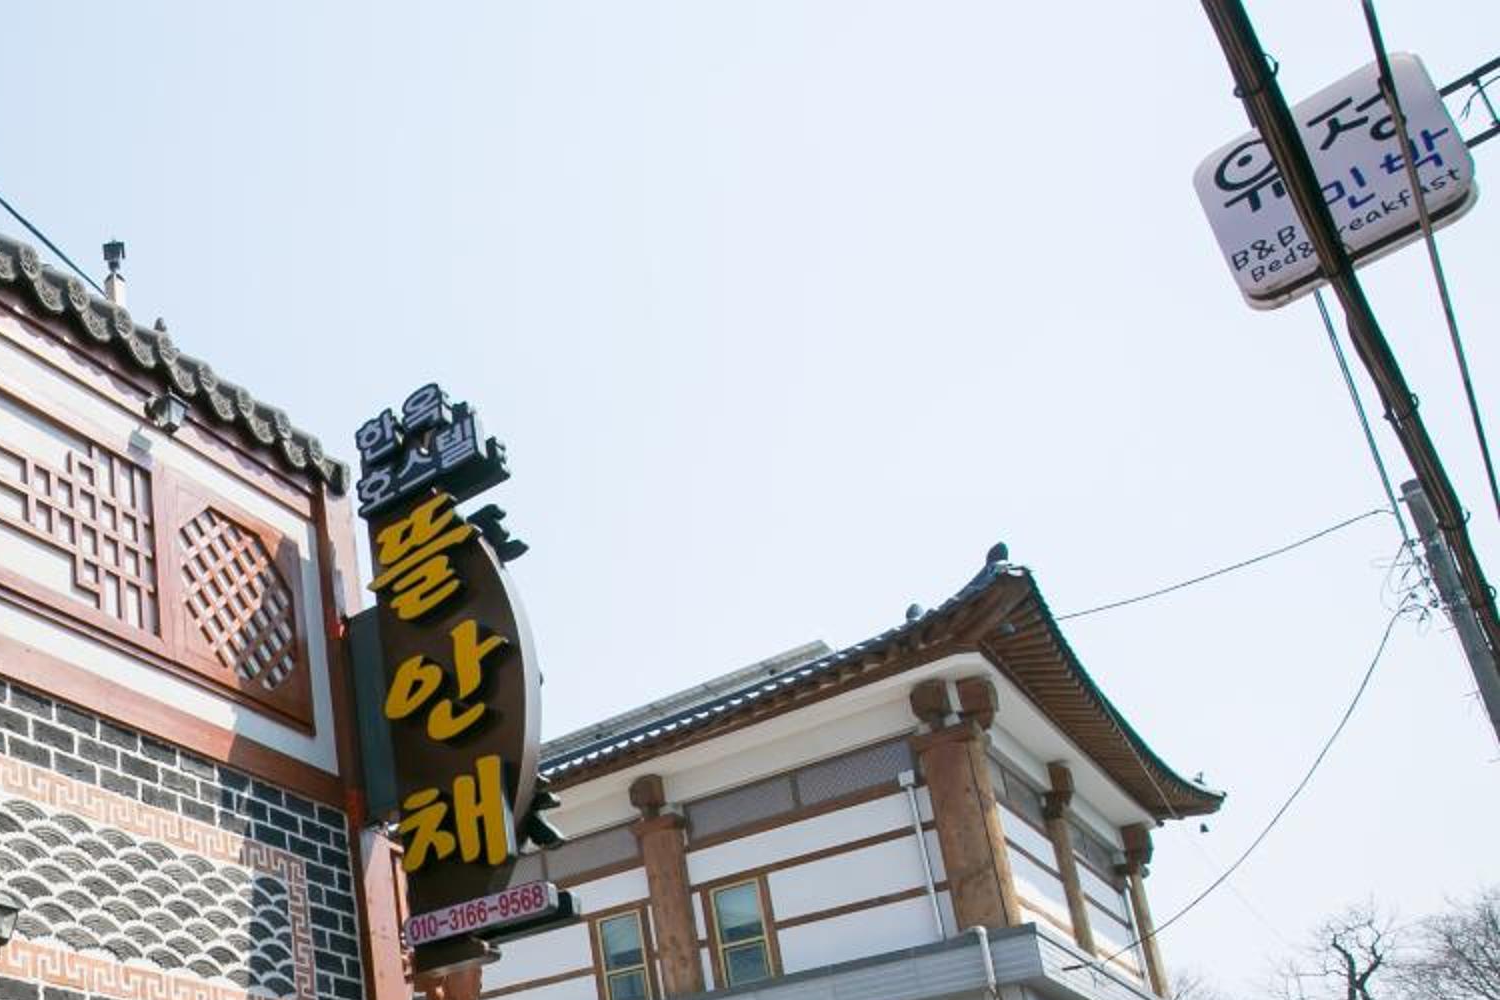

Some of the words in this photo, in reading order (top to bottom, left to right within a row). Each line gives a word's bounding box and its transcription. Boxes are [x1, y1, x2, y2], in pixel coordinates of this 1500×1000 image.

[1322, 127, 1449, 209] 민박
[1231, 224, 1297, 272] B&B
[1251, 168, 1460, 283] Bed&reakfst
[357, 385, 441, 461] 한옥
[360, 415, 475, 513] 호스텔
[367, 492, 509, 872] 뜰안채
[409, 884, 545, 941] 010-3166-9568
